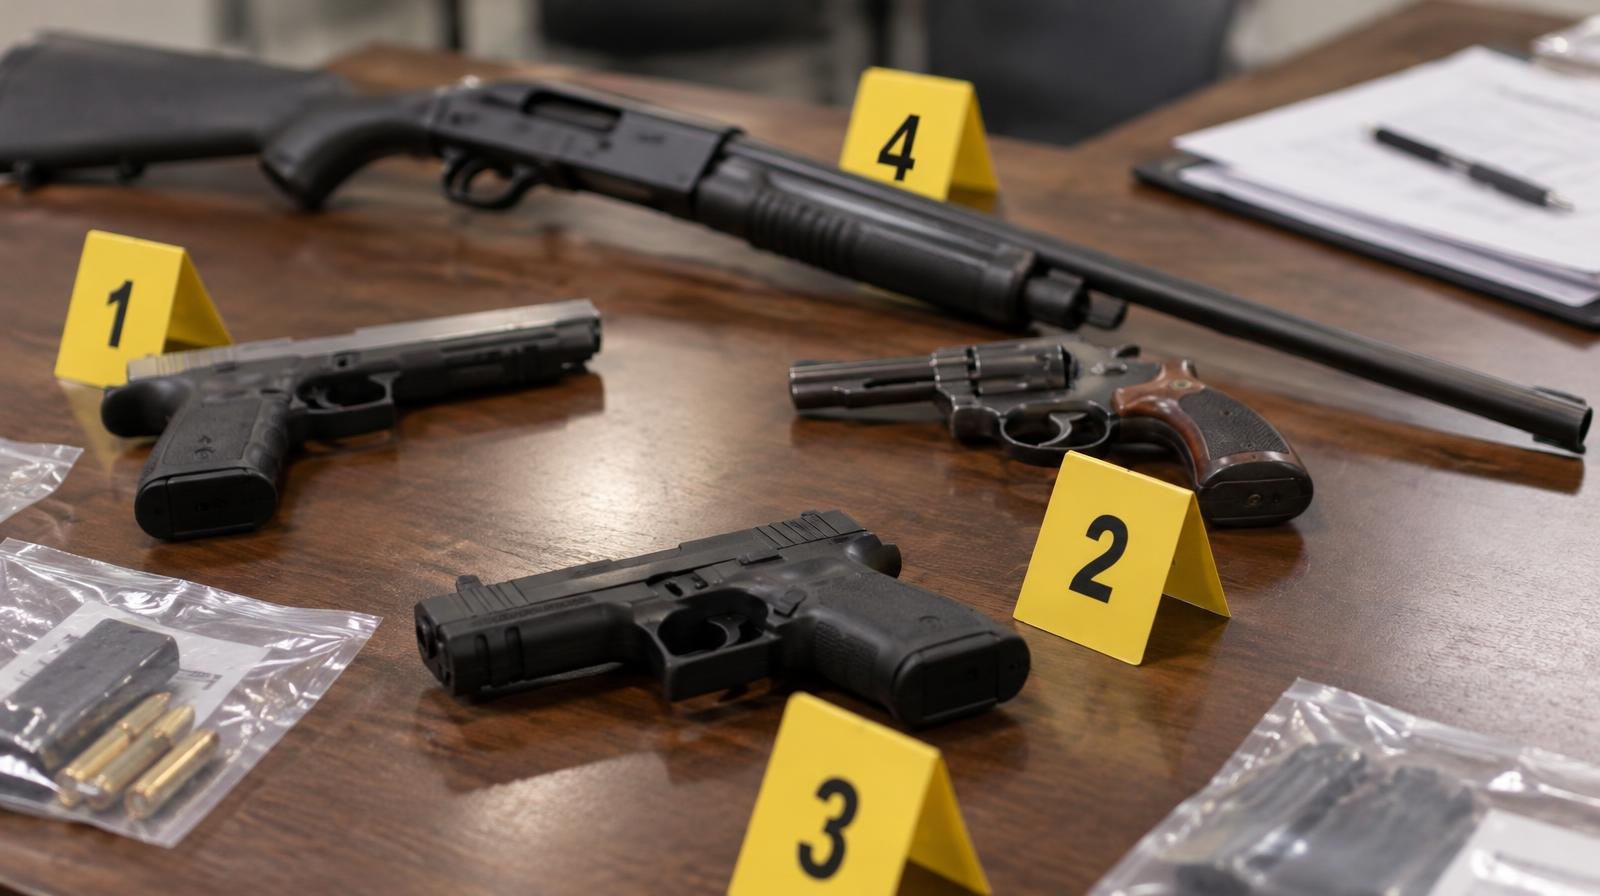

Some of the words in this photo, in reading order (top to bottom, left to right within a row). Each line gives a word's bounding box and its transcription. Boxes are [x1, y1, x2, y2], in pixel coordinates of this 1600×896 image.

[877, 114, 920, 181] 4
[106, 280, 133, 348] 1
[1069, 515, 1129, 604] 2
[798, 778, 859, 880] 3
